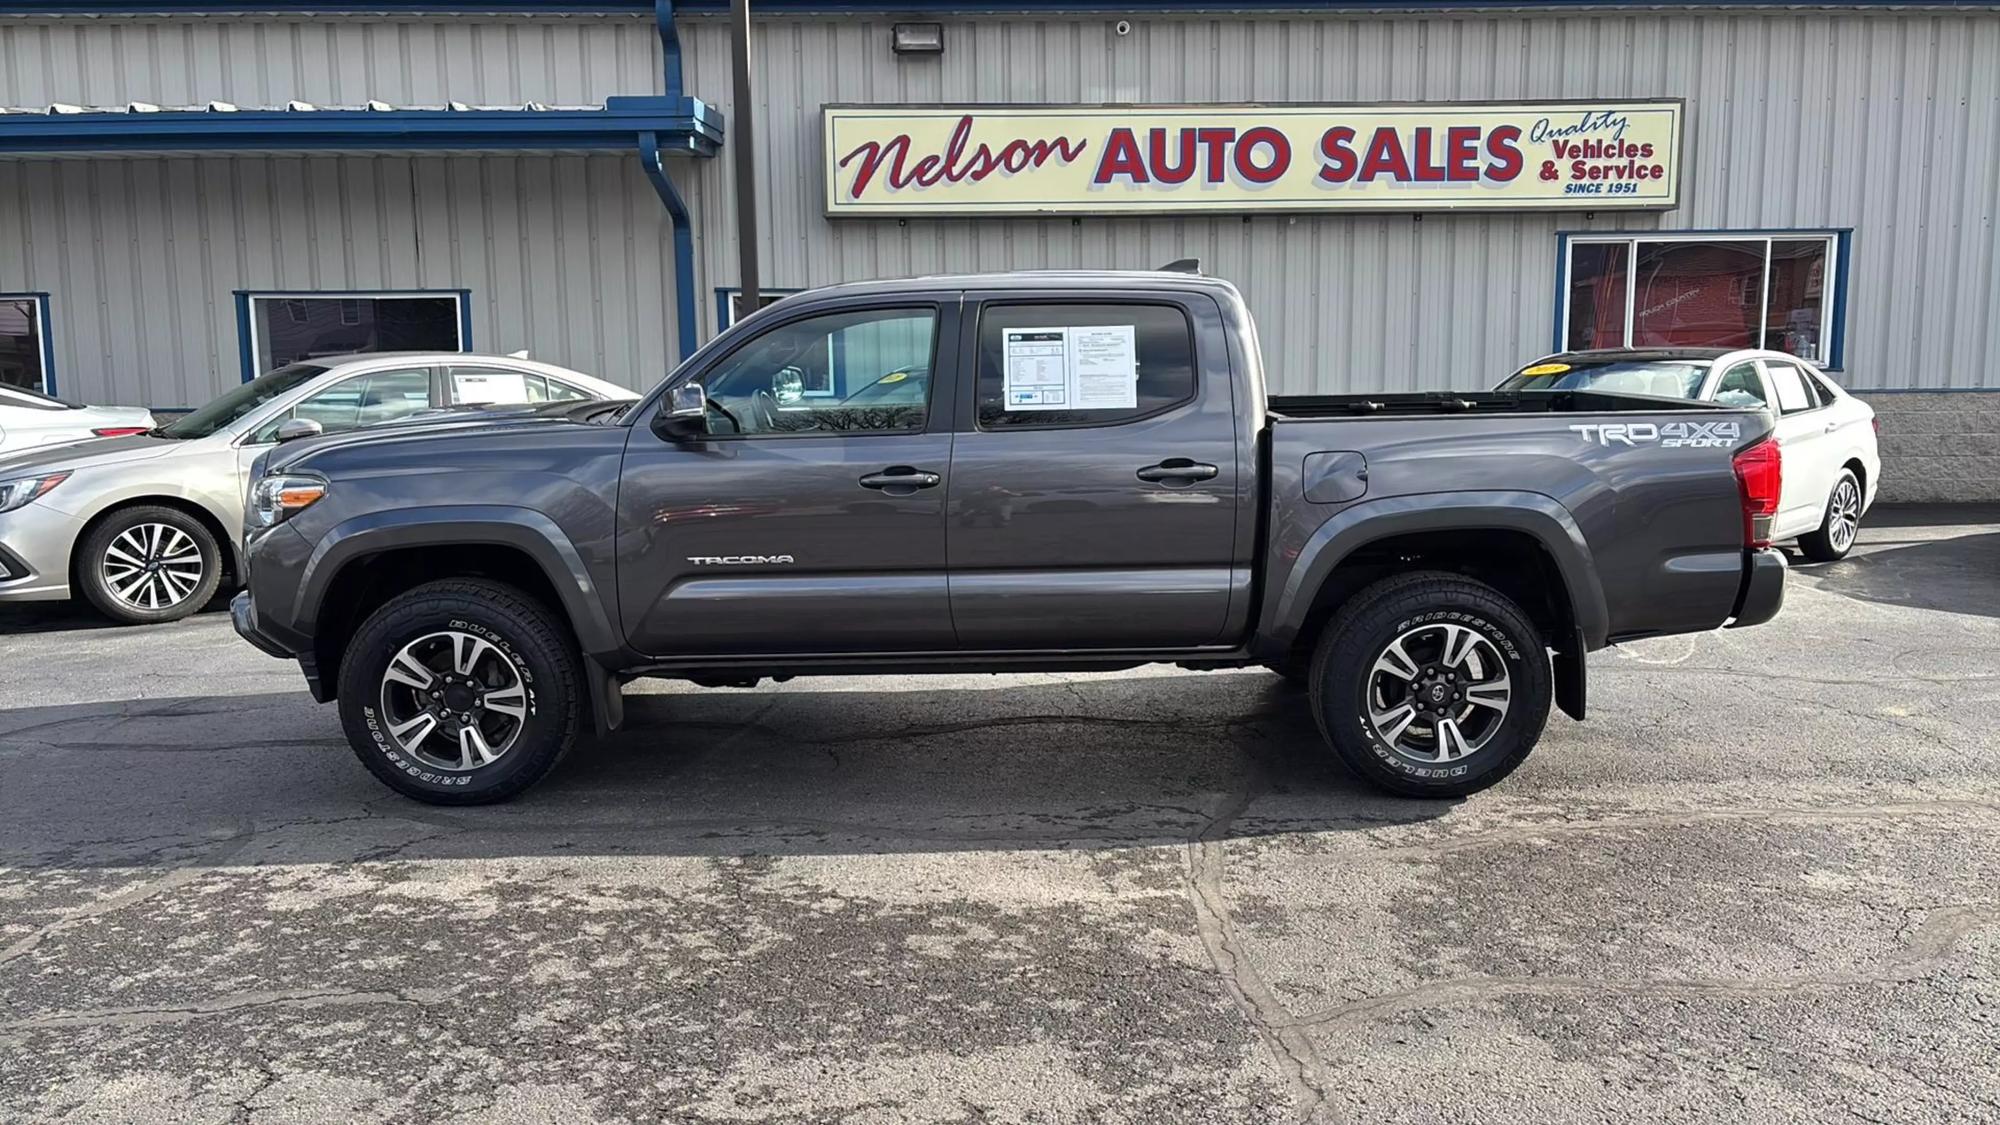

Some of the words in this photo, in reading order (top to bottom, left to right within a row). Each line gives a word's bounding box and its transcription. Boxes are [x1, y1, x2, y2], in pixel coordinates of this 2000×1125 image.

[1530, 110, 1630, 142] Quality
[839, 115, 1087, 199] Nelson
[1094, 126, 1291, 184] AUTO
[1319, 125, 1524, 183] SALES
[1552, 139, 1654, 159] Vehicles
[1540, 160, 1559, 181] &
[1571, 159, 1664, 180] Service
[1565, 183, 1603, 193] SINCE
[1607, 183, 1637, 193] 1951
[1569, 423, 1660, 447] TRD
[1661, 438, 1738, 448] SPORT
[686, 555, 794, 565] TACOMA
[1397, 611, 1521, 661] BRIDGESTONE
[449, 619, 534, 683] DUELER
[364, 706, 472, 785] BRIDGESTONE
[1372, 743, 1468, 778] DUELER
